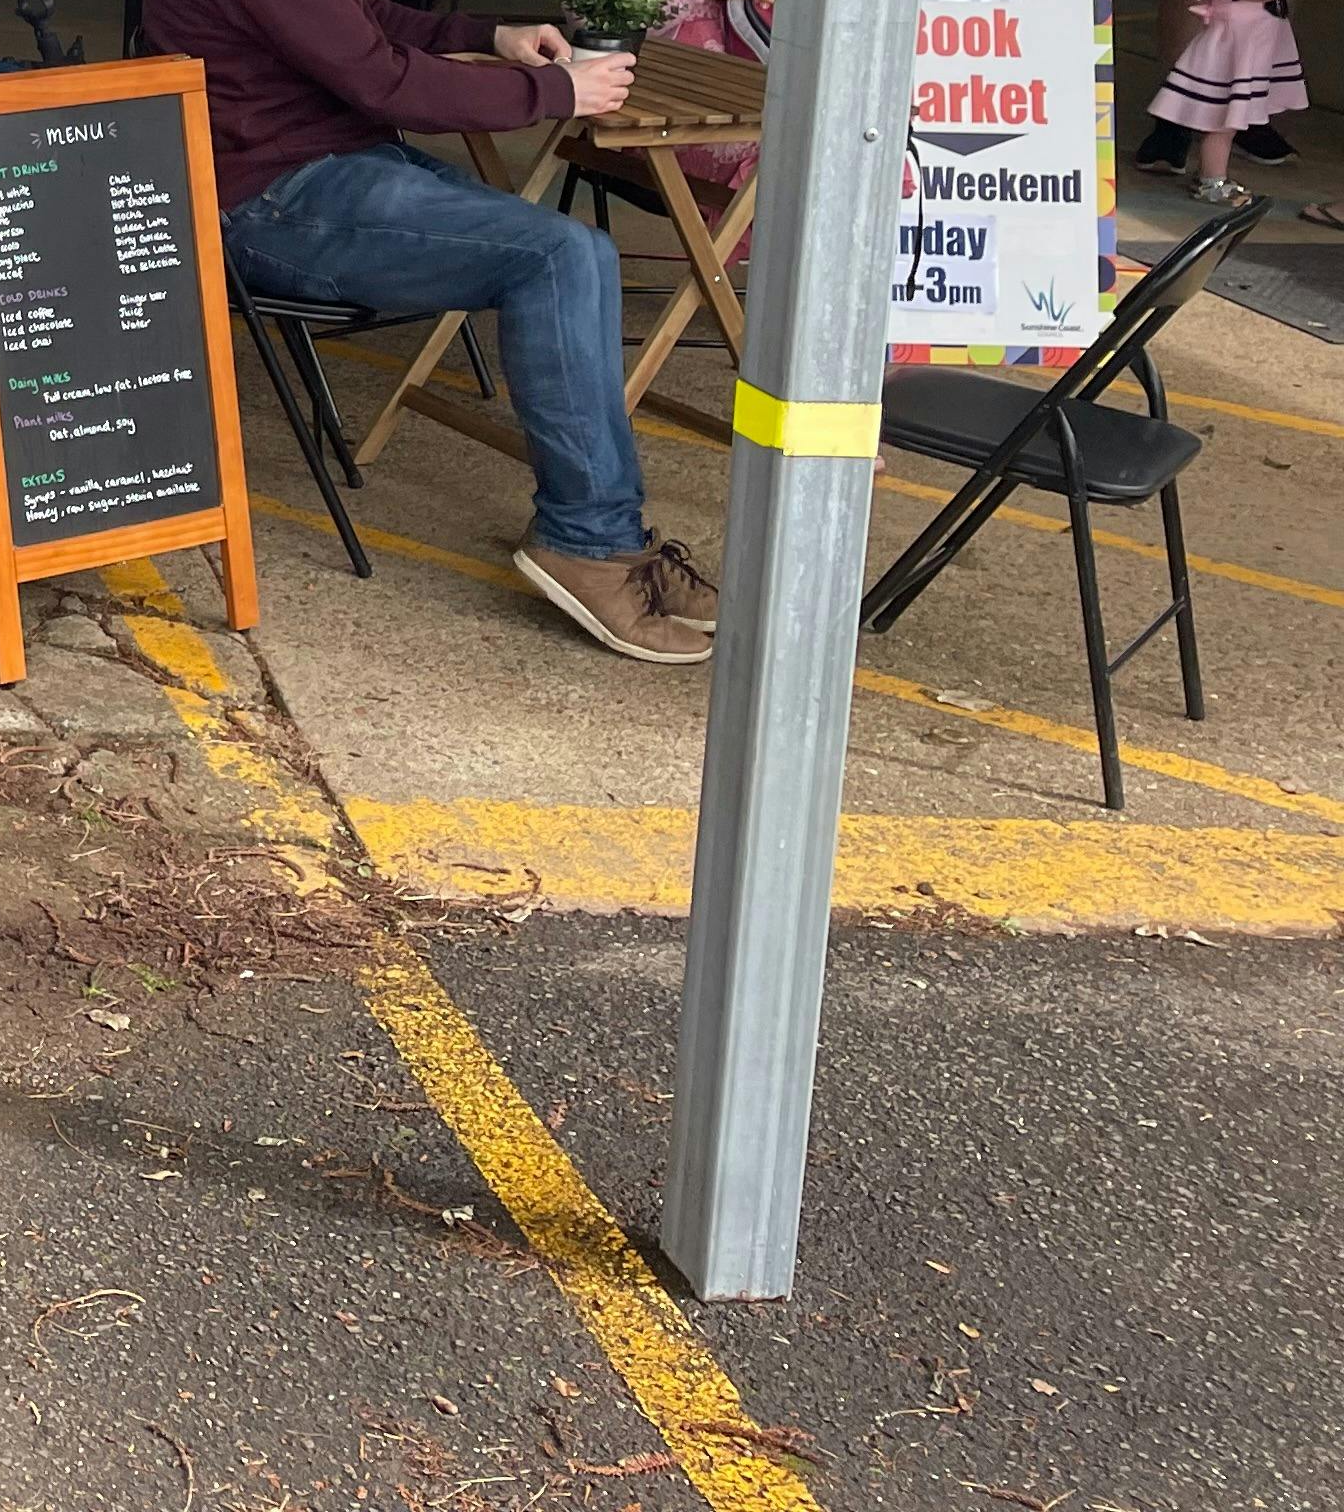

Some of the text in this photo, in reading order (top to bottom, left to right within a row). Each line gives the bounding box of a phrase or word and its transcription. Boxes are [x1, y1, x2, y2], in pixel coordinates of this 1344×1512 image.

[918, 74, 1048, 125] arket
[46, 121, 104, 147] MENU
[12, 159, 59, 178] DRINKS
[108, 171, 131, 186] Chai
[133, 178, 155, 194] Chai
[921, 166, 1082, 203] Weekend
[900, 220, 987, 260] nday
[119, 263, 138, 274] Tea
[0, 286, 69, 306] COLD DRINKS
[0, 306, 56, 324] Iced coffee
[118, 306, 144, 318] Juice
[2, 316, 75, 338] Iced chocolate
[120, 318, 152, 331] Water
[3, 333, 53, 352] Iced chai
[8, 377, 39, 395] Dairy
[43, 390, 61, 404] Full
[13, 414, 43, 430] Plant
[21, 468, 66, 488] EXTRAS
[23, 489, 57, 510] Syrups
